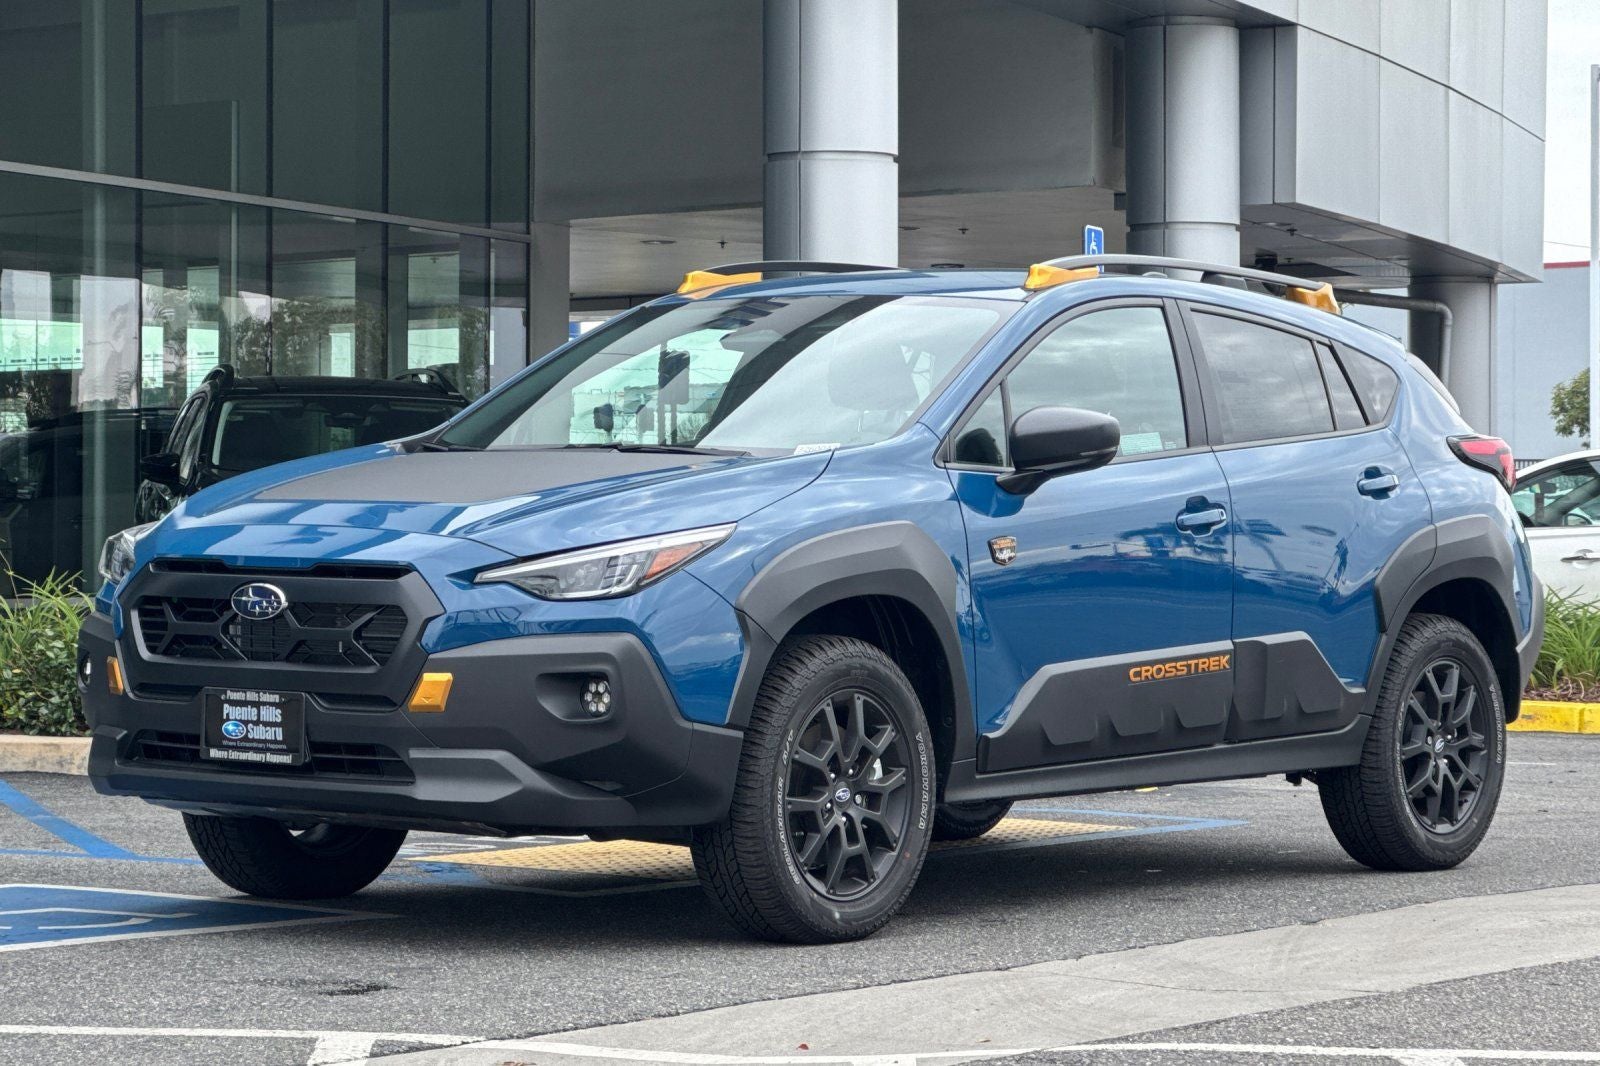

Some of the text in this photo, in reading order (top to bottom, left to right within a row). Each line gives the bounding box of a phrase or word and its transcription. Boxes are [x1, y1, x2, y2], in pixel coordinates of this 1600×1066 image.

[1129, 654, 1231, 682] CROSSTREK
[226, 690, 280, 703] Puente Hills Subaru
[223, 703, 282, 723] Puente Hills
[247, 723, 283, 741] Subaru
[209, 748, 292, 764] Where Extraordinary Happens!
[915, 731, 929, 830] YOKOHAMA
